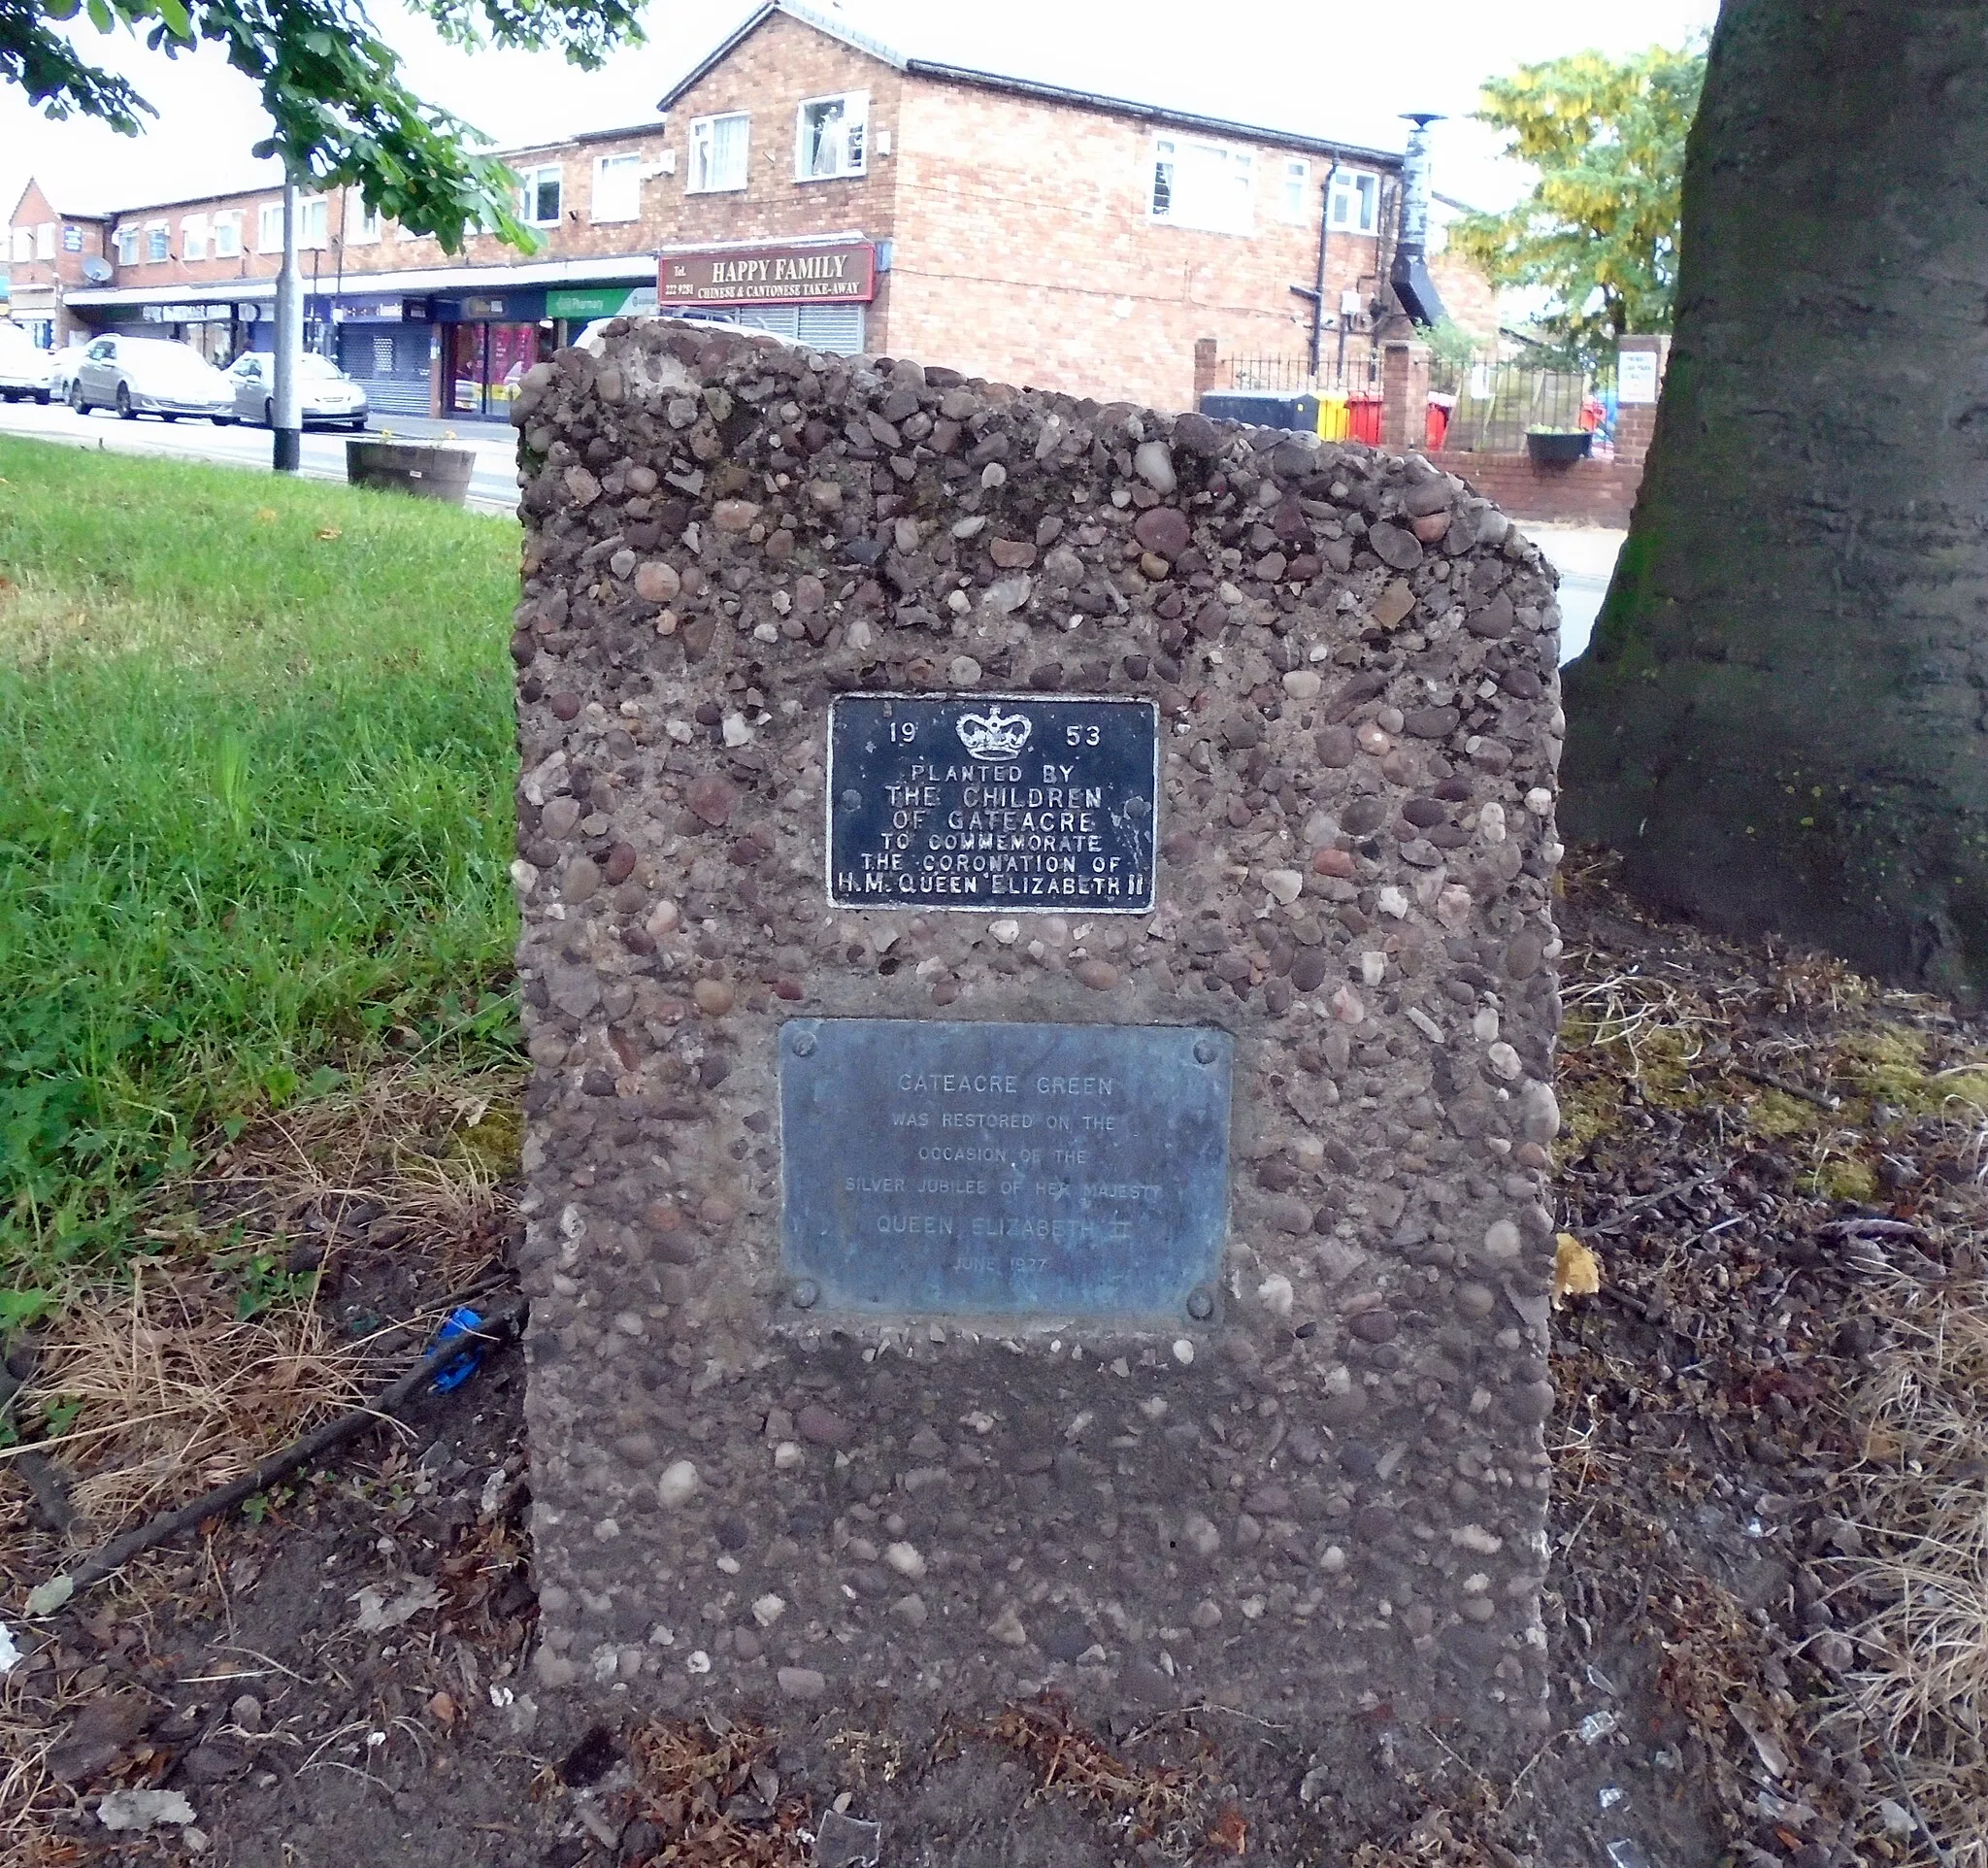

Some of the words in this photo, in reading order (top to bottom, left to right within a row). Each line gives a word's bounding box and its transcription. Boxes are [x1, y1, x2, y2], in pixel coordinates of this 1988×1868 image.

[674, 265, 686, 277] Tel.
[712, 259, 771, 284] HAPPY
[776, 255, 847, 281] FAMILY
[698, 286, 735, 299] CHINESE
[737, 286, 744, 297] &
[746, 284, 801, 297] CANTONESE
[803, 282, 860, 295] TAKE-AWAY
[889, 722, 915, 743] 19
[1066, 726, 1101, 747] 53
[911, 764, 1022, 783] PLANTED
[1043, 765, 1075, 783] BY
[885, 785, 941, 807] THE
[964, 787, 1102, 809] CHILDREN
[892, 811, 927, 829] OF
[948, 812, 1095, 832] GATEACRE
[881, 833, 909, 851] TO
[929, 833, 1102, 851] COMMEMORATE
[861, 853, 902, 871] THE
[923, 854, 1076, 873] CORONATION
[1092, 856, 1120, 873] OF
[899, 875, 977, 894] QUEEN
[992, 875, 1120, 895] ELIZABETH
[1128, 874, 1143, 896] II
[900, 1074, 1017, 1094] GATEACRE
[1037, 1077, 1113, 1095] GREEN
[893, 1113, 929, 1127] WAS
[943, 1113, 1033, 1129] RESTORED
[1046, 1116, 1070, 1130] ON
[1082, 1116, 1114, 1131] THE
[919, 1147, 1007, 1163] OCCASION
[1019, 1148, 1042, 1163] OF
[1054, 1149, 1086, 1164] THE
[846, 1177, 905, 1192] SILVER
[917, 1178, 985, 1194] JUBILEE
[1001, 1180, 1021, 1195] OF
[1035, 1181, 1070, 1196] HER
[1082, 1184, 1162, 1198] MAJESTY
[878, 1216, 952, 1236] QUEEN
[972, 1218, 1093, 1238] ELIZABETH
[952, 1258, 995, 1271] JUNE
